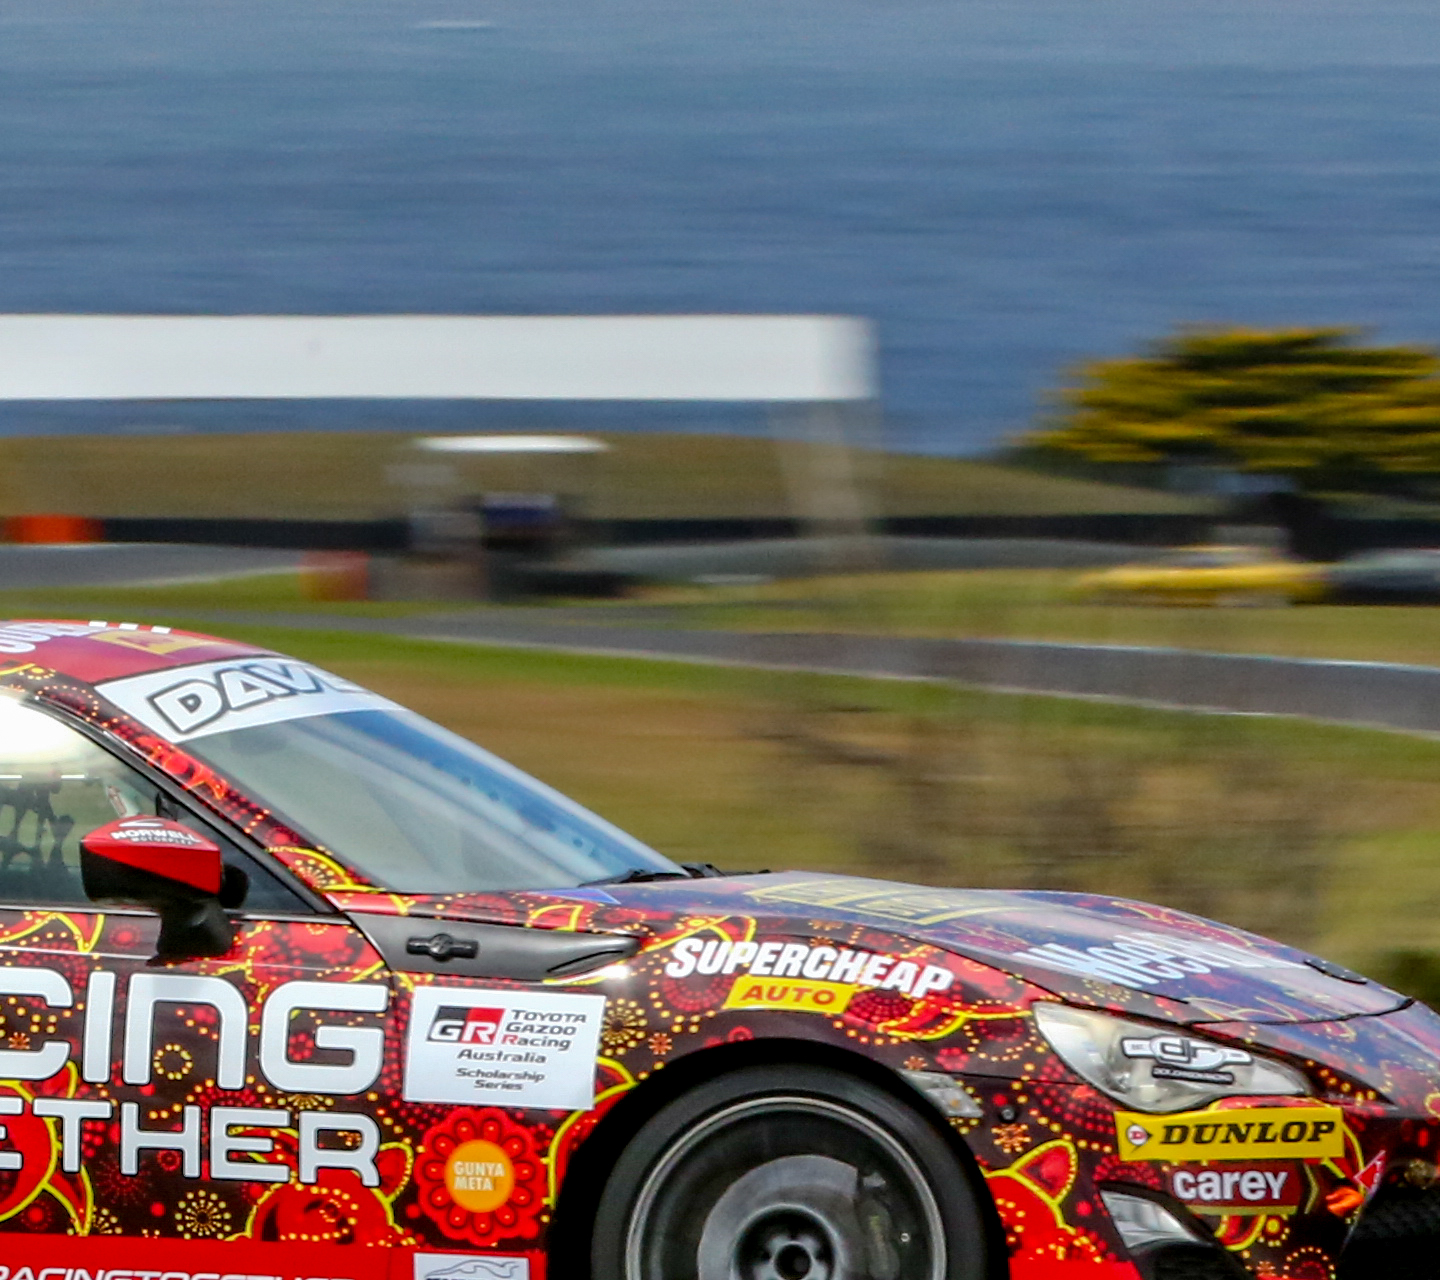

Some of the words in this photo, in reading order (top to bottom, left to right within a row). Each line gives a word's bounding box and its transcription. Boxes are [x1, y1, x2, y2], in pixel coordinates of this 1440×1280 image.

[110, 829, 202, 843] NORWELL
[665, 938, 954, 998] SUPERCHEAP
[740, 985, 836, 1005] AUTO
[511, 1009, 587, 1023] TOYOTA
[429, 1019, 498, 1043] GR
[505, 1022, 577, 1035] GAZOO
[501, 1034, 572, 1051] Racing
[457, 1049, 547, 1063] Australia
[456, 1068, 545, 1083] Scholarship
[474, 1080, 523, 1090] Series
[1160, 1121, 1335, 1144] DUNLOP
[454, 1161, 504, 1177] GUNYA
[454, 1176, 493, 1191] META
